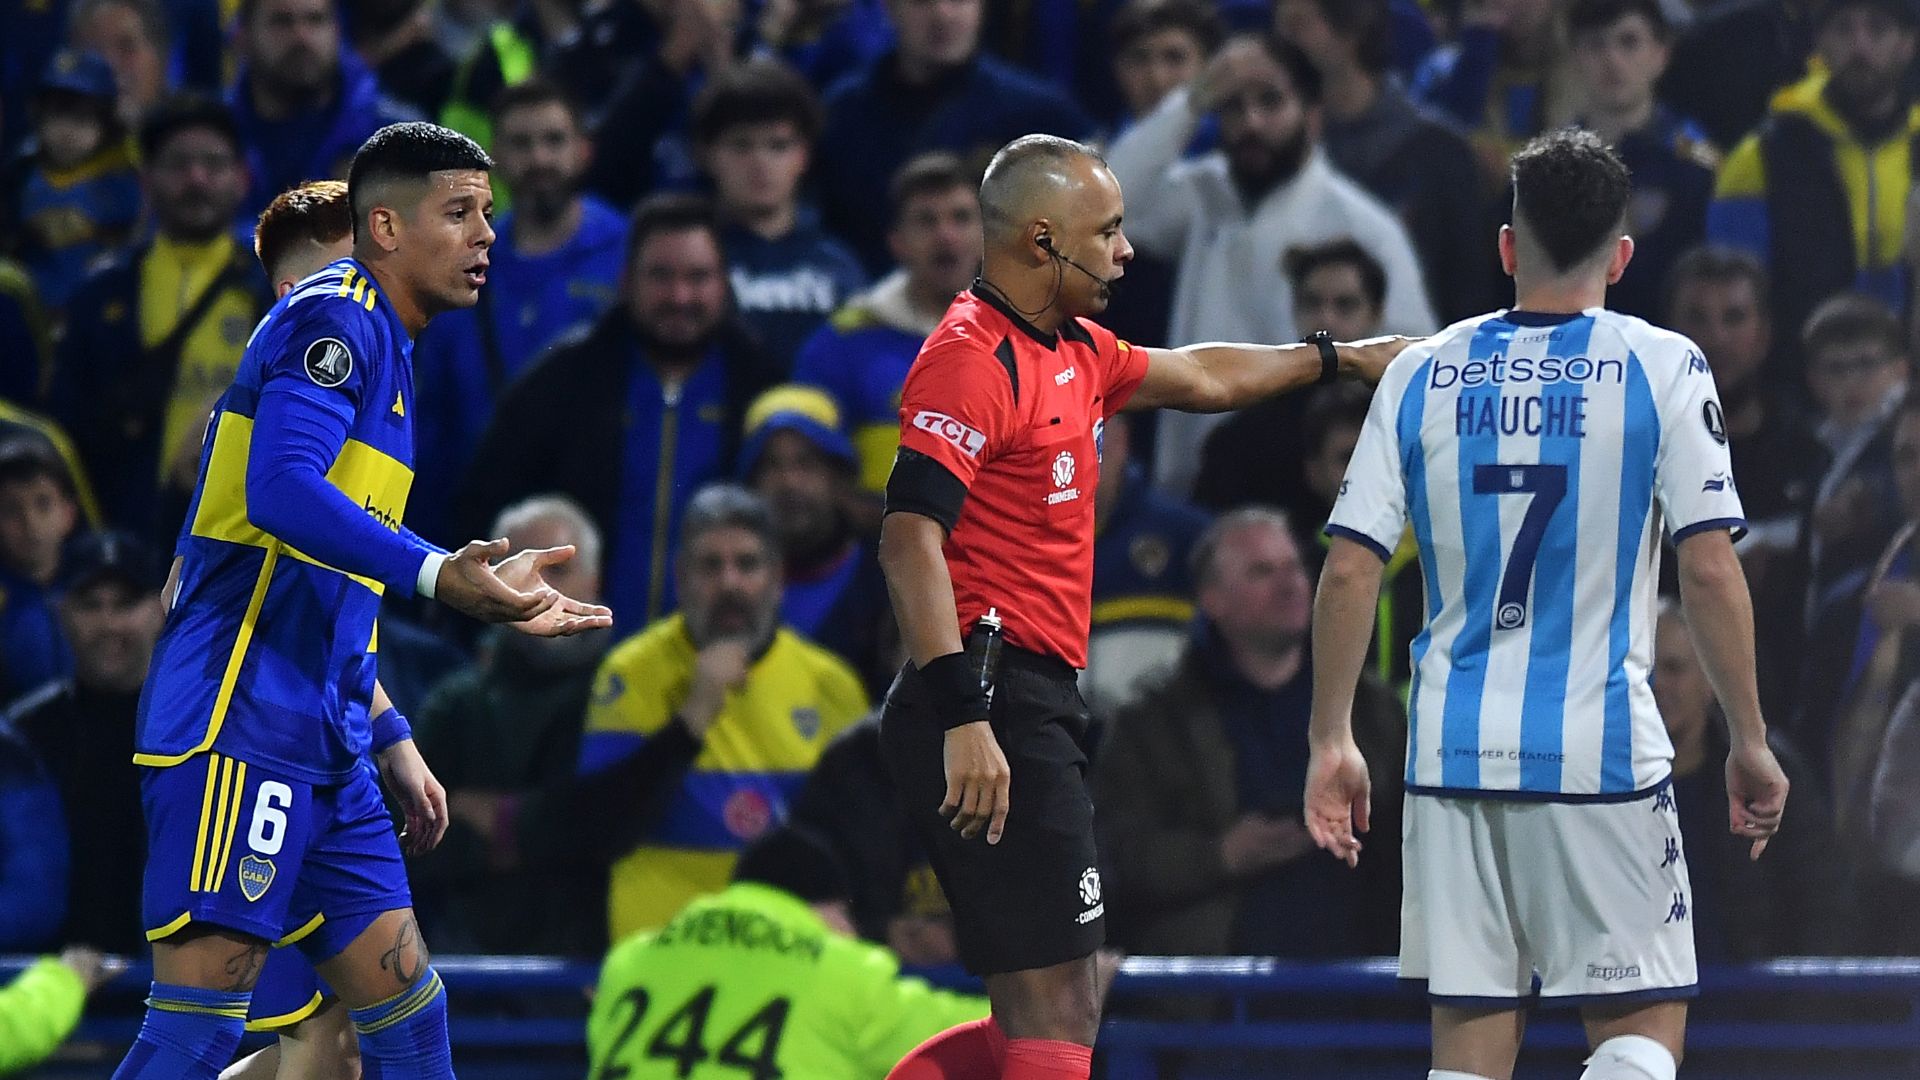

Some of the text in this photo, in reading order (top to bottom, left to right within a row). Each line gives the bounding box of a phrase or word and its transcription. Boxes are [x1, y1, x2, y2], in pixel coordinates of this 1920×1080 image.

[1430, 353, 1623, 390] betsson
[924, 415, 973, 452] TCL
[1456, 396, 1588, 438] HAUCHE
[1473, 464, 1568, 630] 7
[1454, 748, 1504, 760] PRIMER
[1508, 750, 1566, 763] GRANDE
[248, 780, 292, 855] 6
[242, 870, 269, 884] CABJ
[599, 984, 792, 1080] 244
